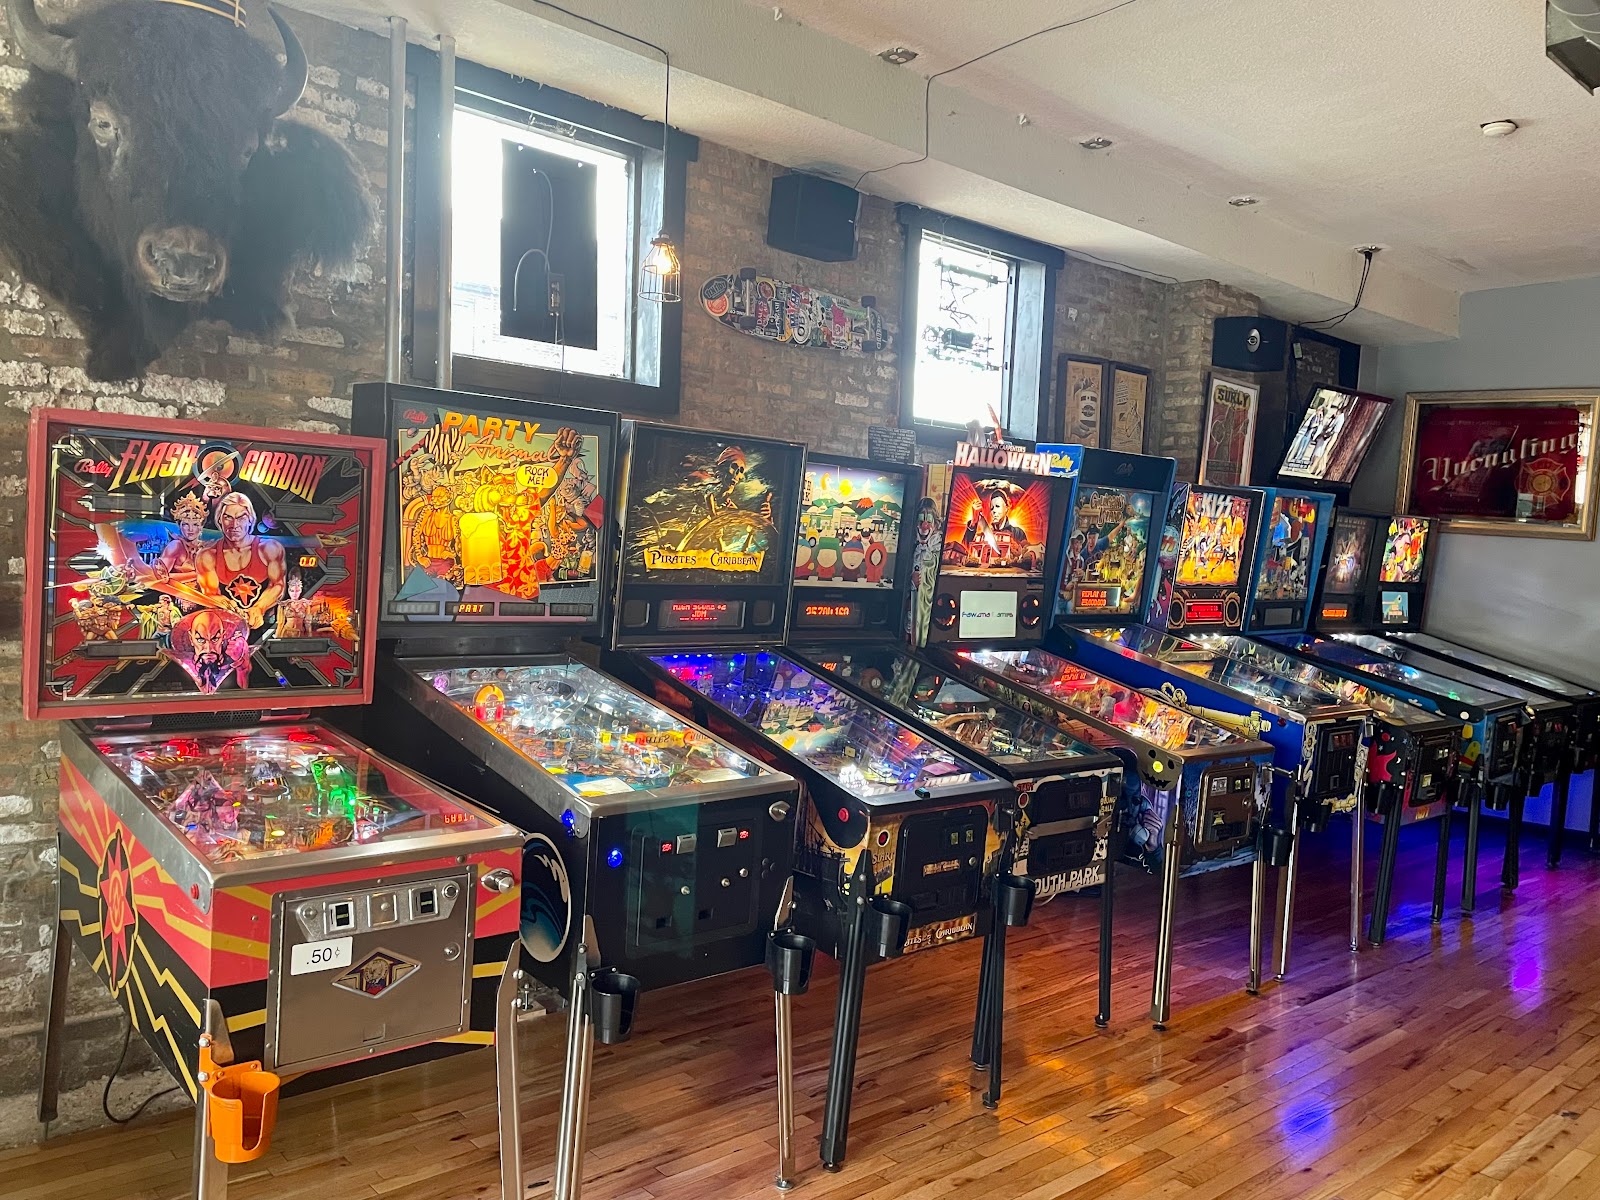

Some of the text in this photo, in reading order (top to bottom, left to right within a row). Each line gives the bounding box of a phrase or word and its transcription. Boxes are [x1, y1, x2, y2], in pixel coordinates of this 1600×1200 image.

[1217, 388, 1250, 408] SURLY
[403, 410, 428, 424] Bally
[441, 411, 540, 442] PARTY
[468, 434, 560, 463] Animal
[74, 458, 112, 477] Bally
[953, 441, 1052, 476] HALLOWEEN
[1423, 432, 1578, 493] Yuengling
[107, 440, 328, 504] FLASH GORDON
[524, 466, 549, 477] ROCK
[527, 475, 545, 486] ME!
[1201, 493, 1233, 518] KISS
[648, 550, 697, 566] PIRATES
[710, 552, 759, 567] CARIBBEAN
[1016, 782, 1035, 791] START
[872, 851, 895, 865] START
[1035, 865, 1100, 895] OUTH PARK
[306, 946, 341, 965] .50¢
